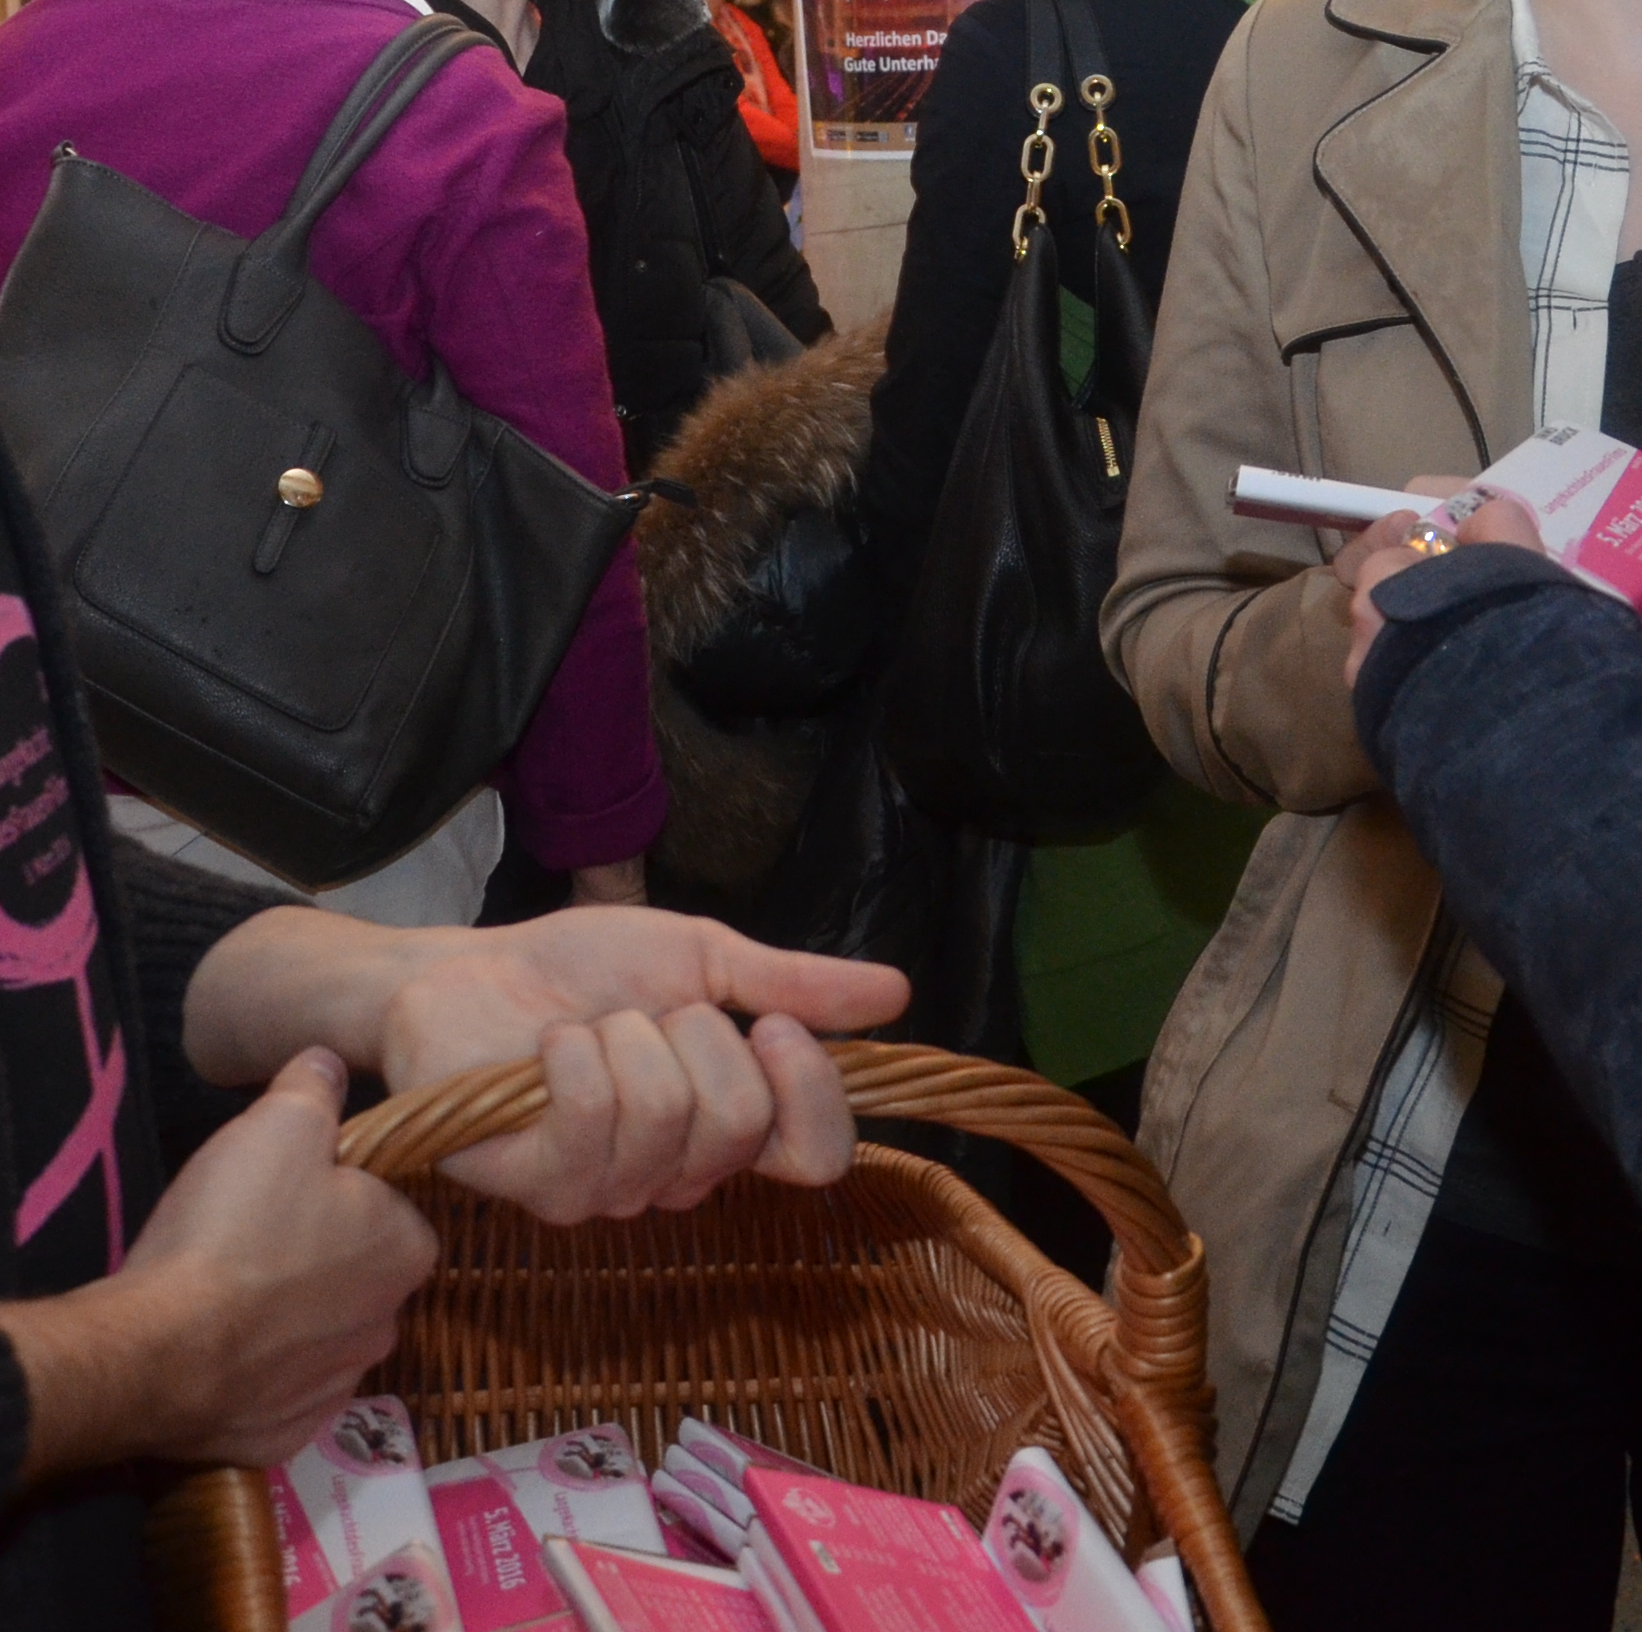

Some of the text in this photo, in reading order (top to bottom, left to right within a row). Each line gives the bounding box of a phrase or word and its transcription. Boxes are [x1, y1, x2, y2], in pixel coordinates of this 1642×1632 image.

[846, 29, 922, 48] Herzlichen
[844, 54, 939, 72] Gute Unterh
[488, 1525, 518, 1555] März
[495, 1553, 527, 1592] 2016
